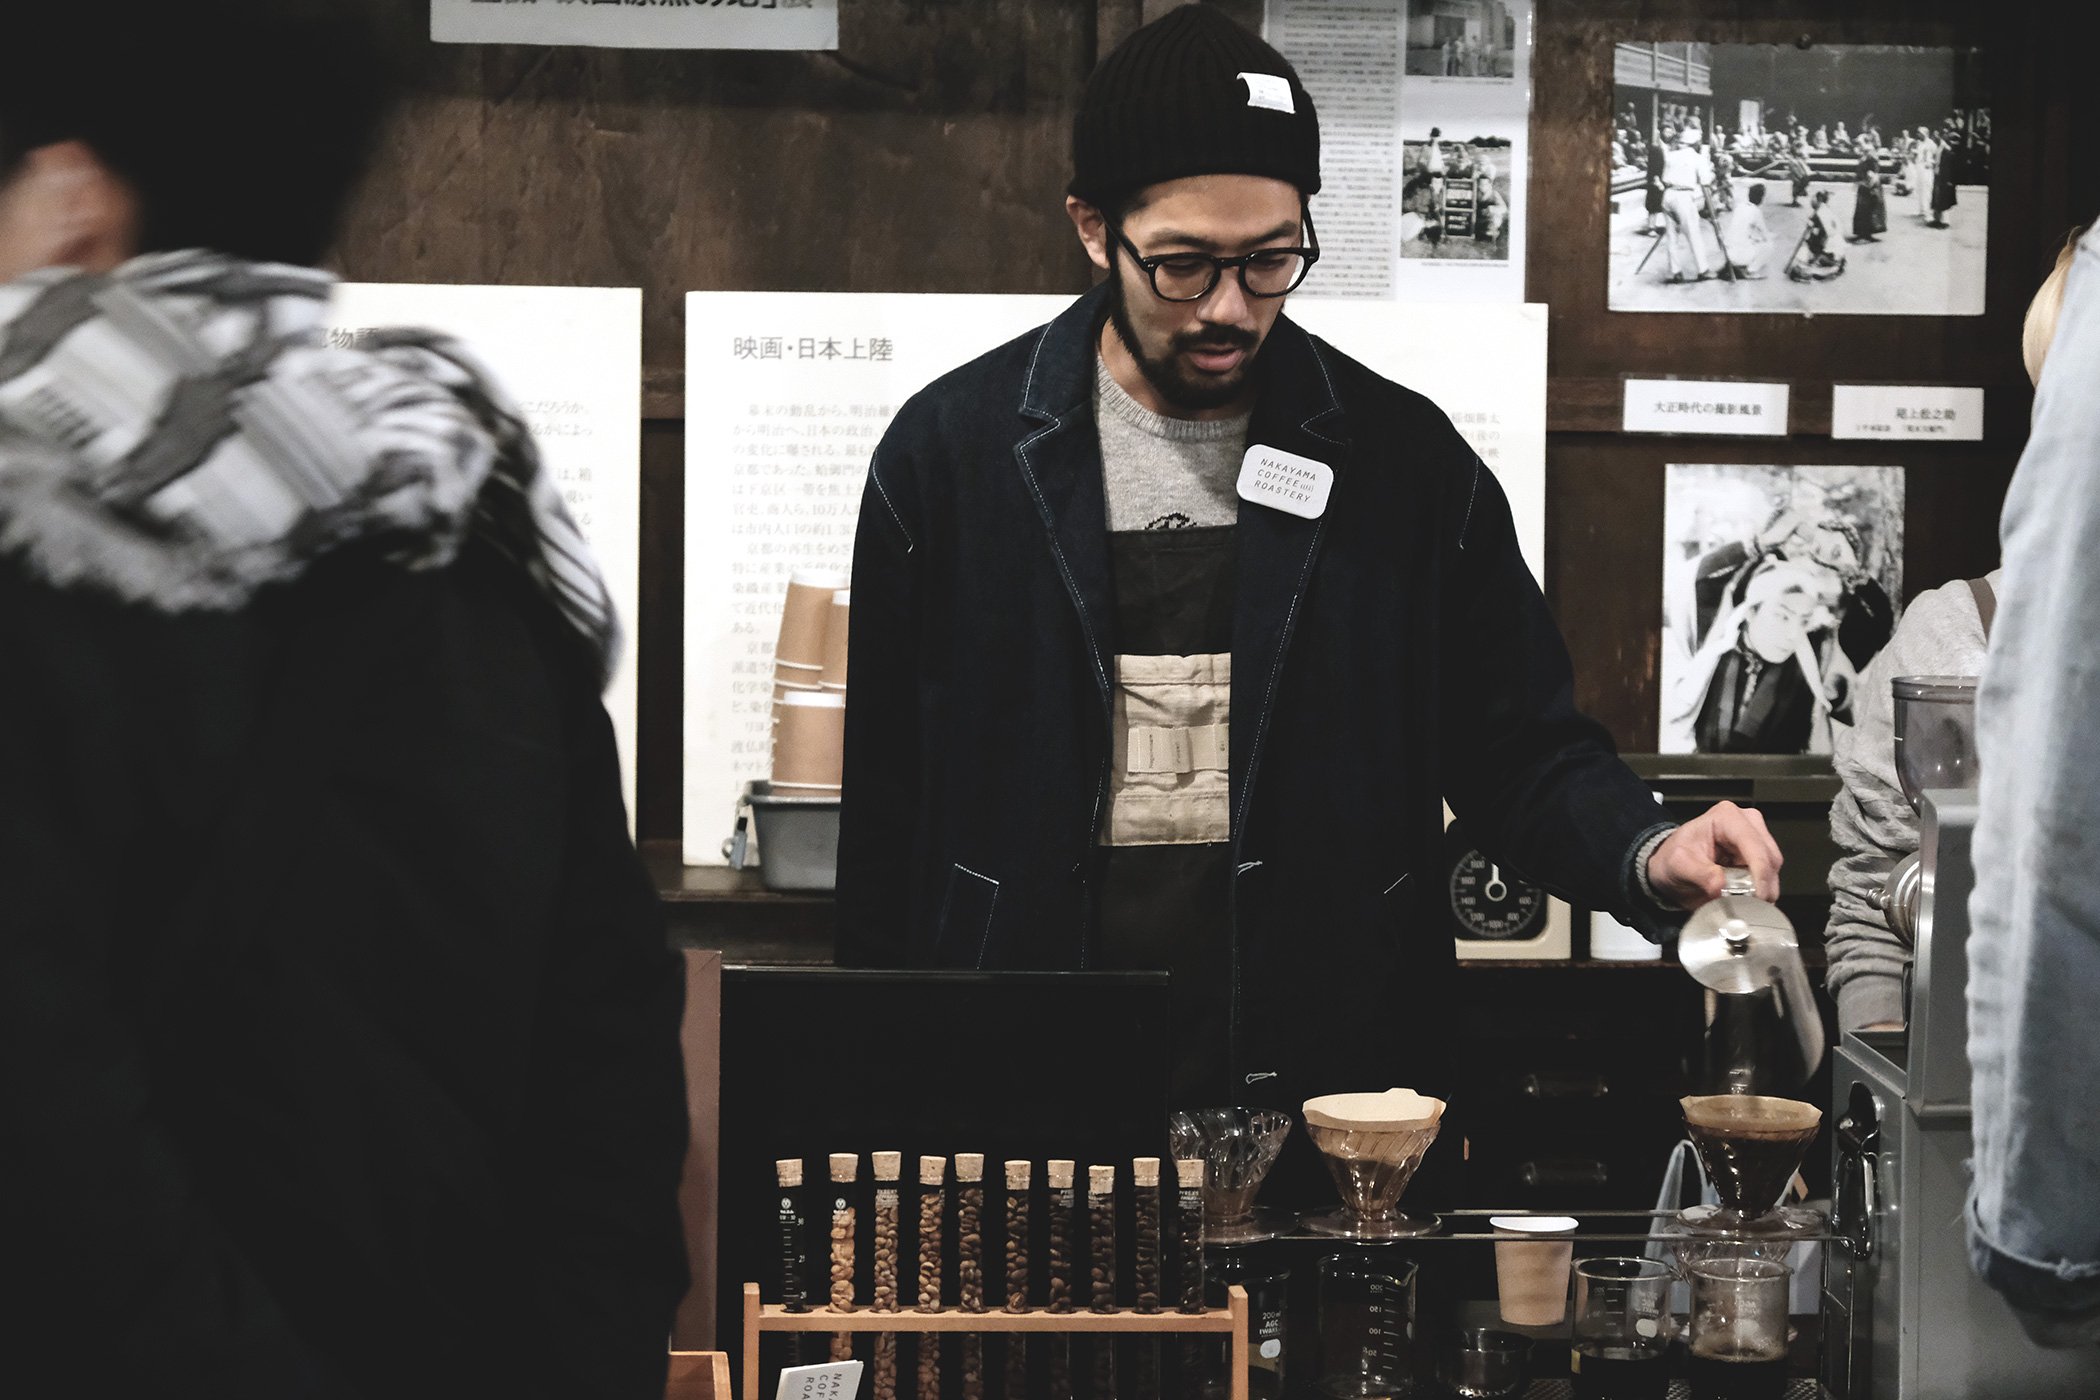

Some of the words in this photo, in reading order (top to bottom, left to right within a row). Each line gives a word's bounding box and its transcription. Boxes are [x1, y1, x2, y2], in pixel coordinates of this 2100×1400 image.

[733, 336, 893, 362] 映画・日本上陸
[1654, 401, 1763, 416] 大正時代の撮影風景
[1257, 469, 1300, 488] COFFEE
[1260, 458, 1316, 481] NAKAYAMA
[1254, 480, 1311, 503] ROASTERY
[829, 1373, 843, 1400] NAK
